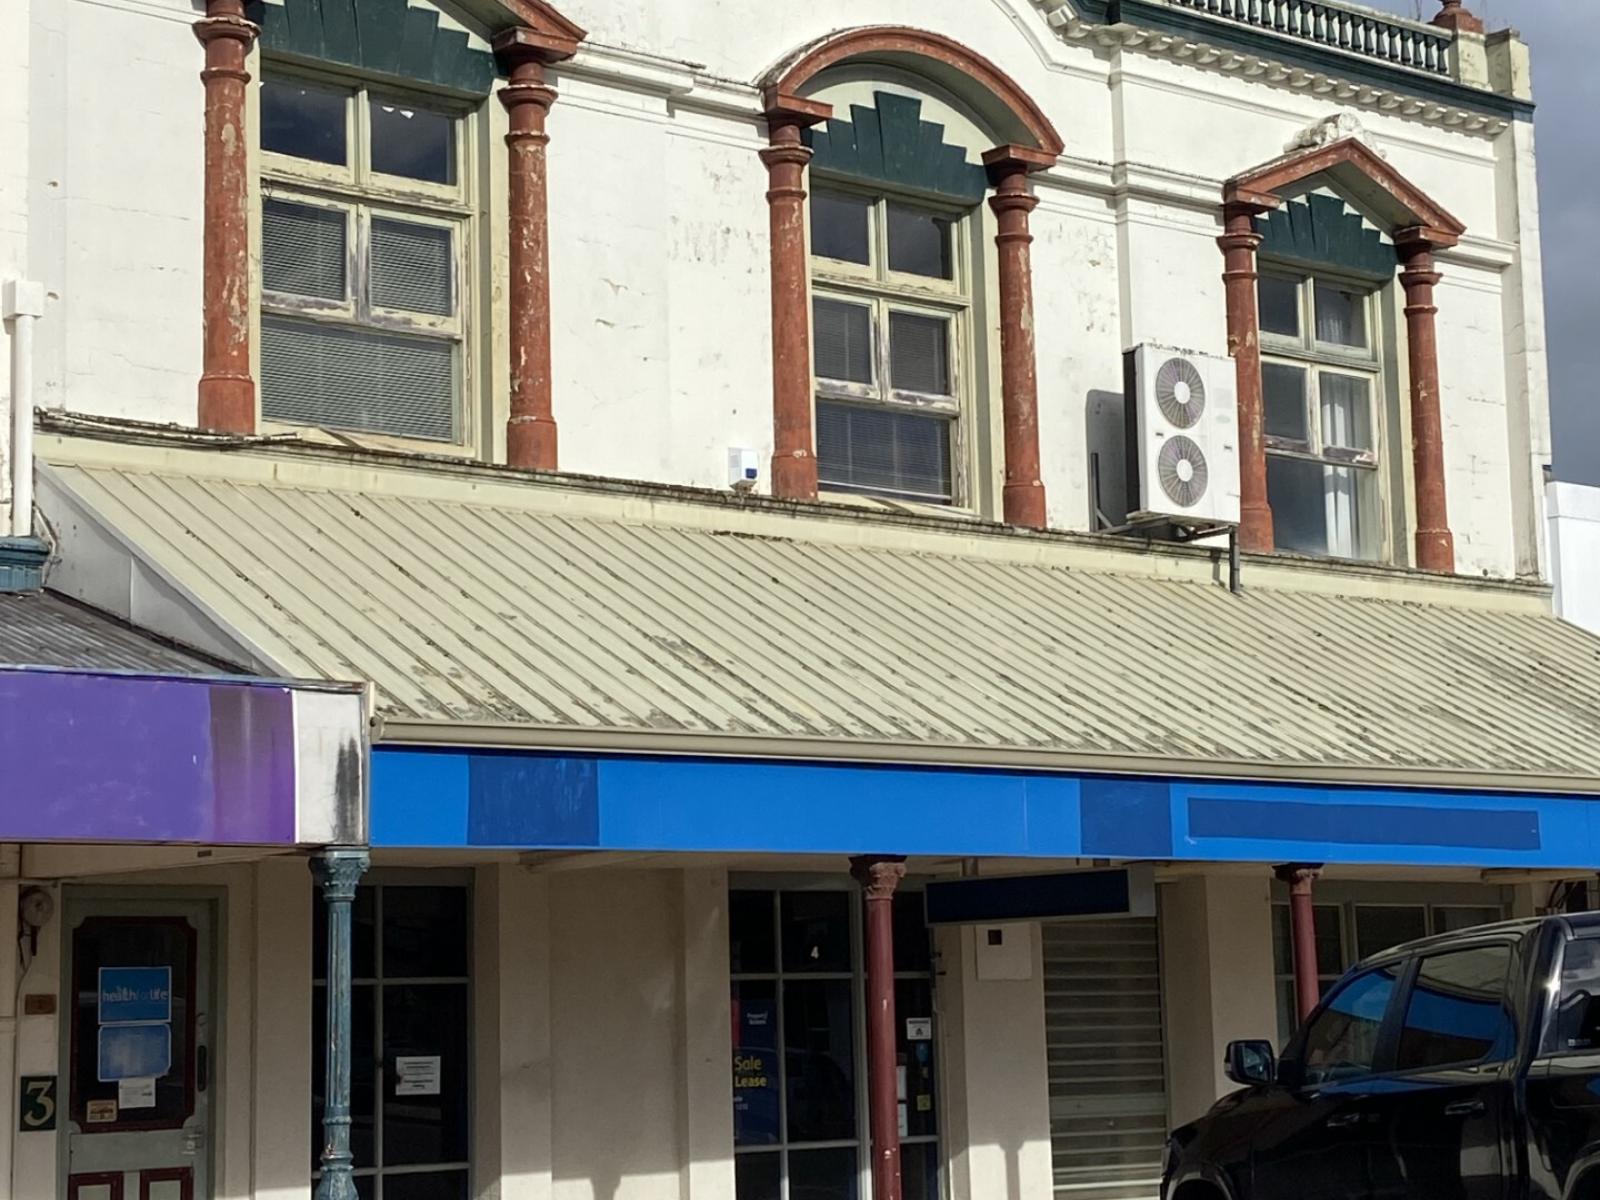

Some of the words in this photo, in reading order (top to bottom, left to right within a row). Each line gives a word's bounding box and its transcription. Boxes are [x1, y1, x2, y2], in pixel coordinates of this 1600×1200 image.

[810, 946, 820, 959] 4
[734, 1056, 762, 1070] Sale
[735, 1076, 767, 1088] Lease
[24, 1081, 54, 1126] 3
